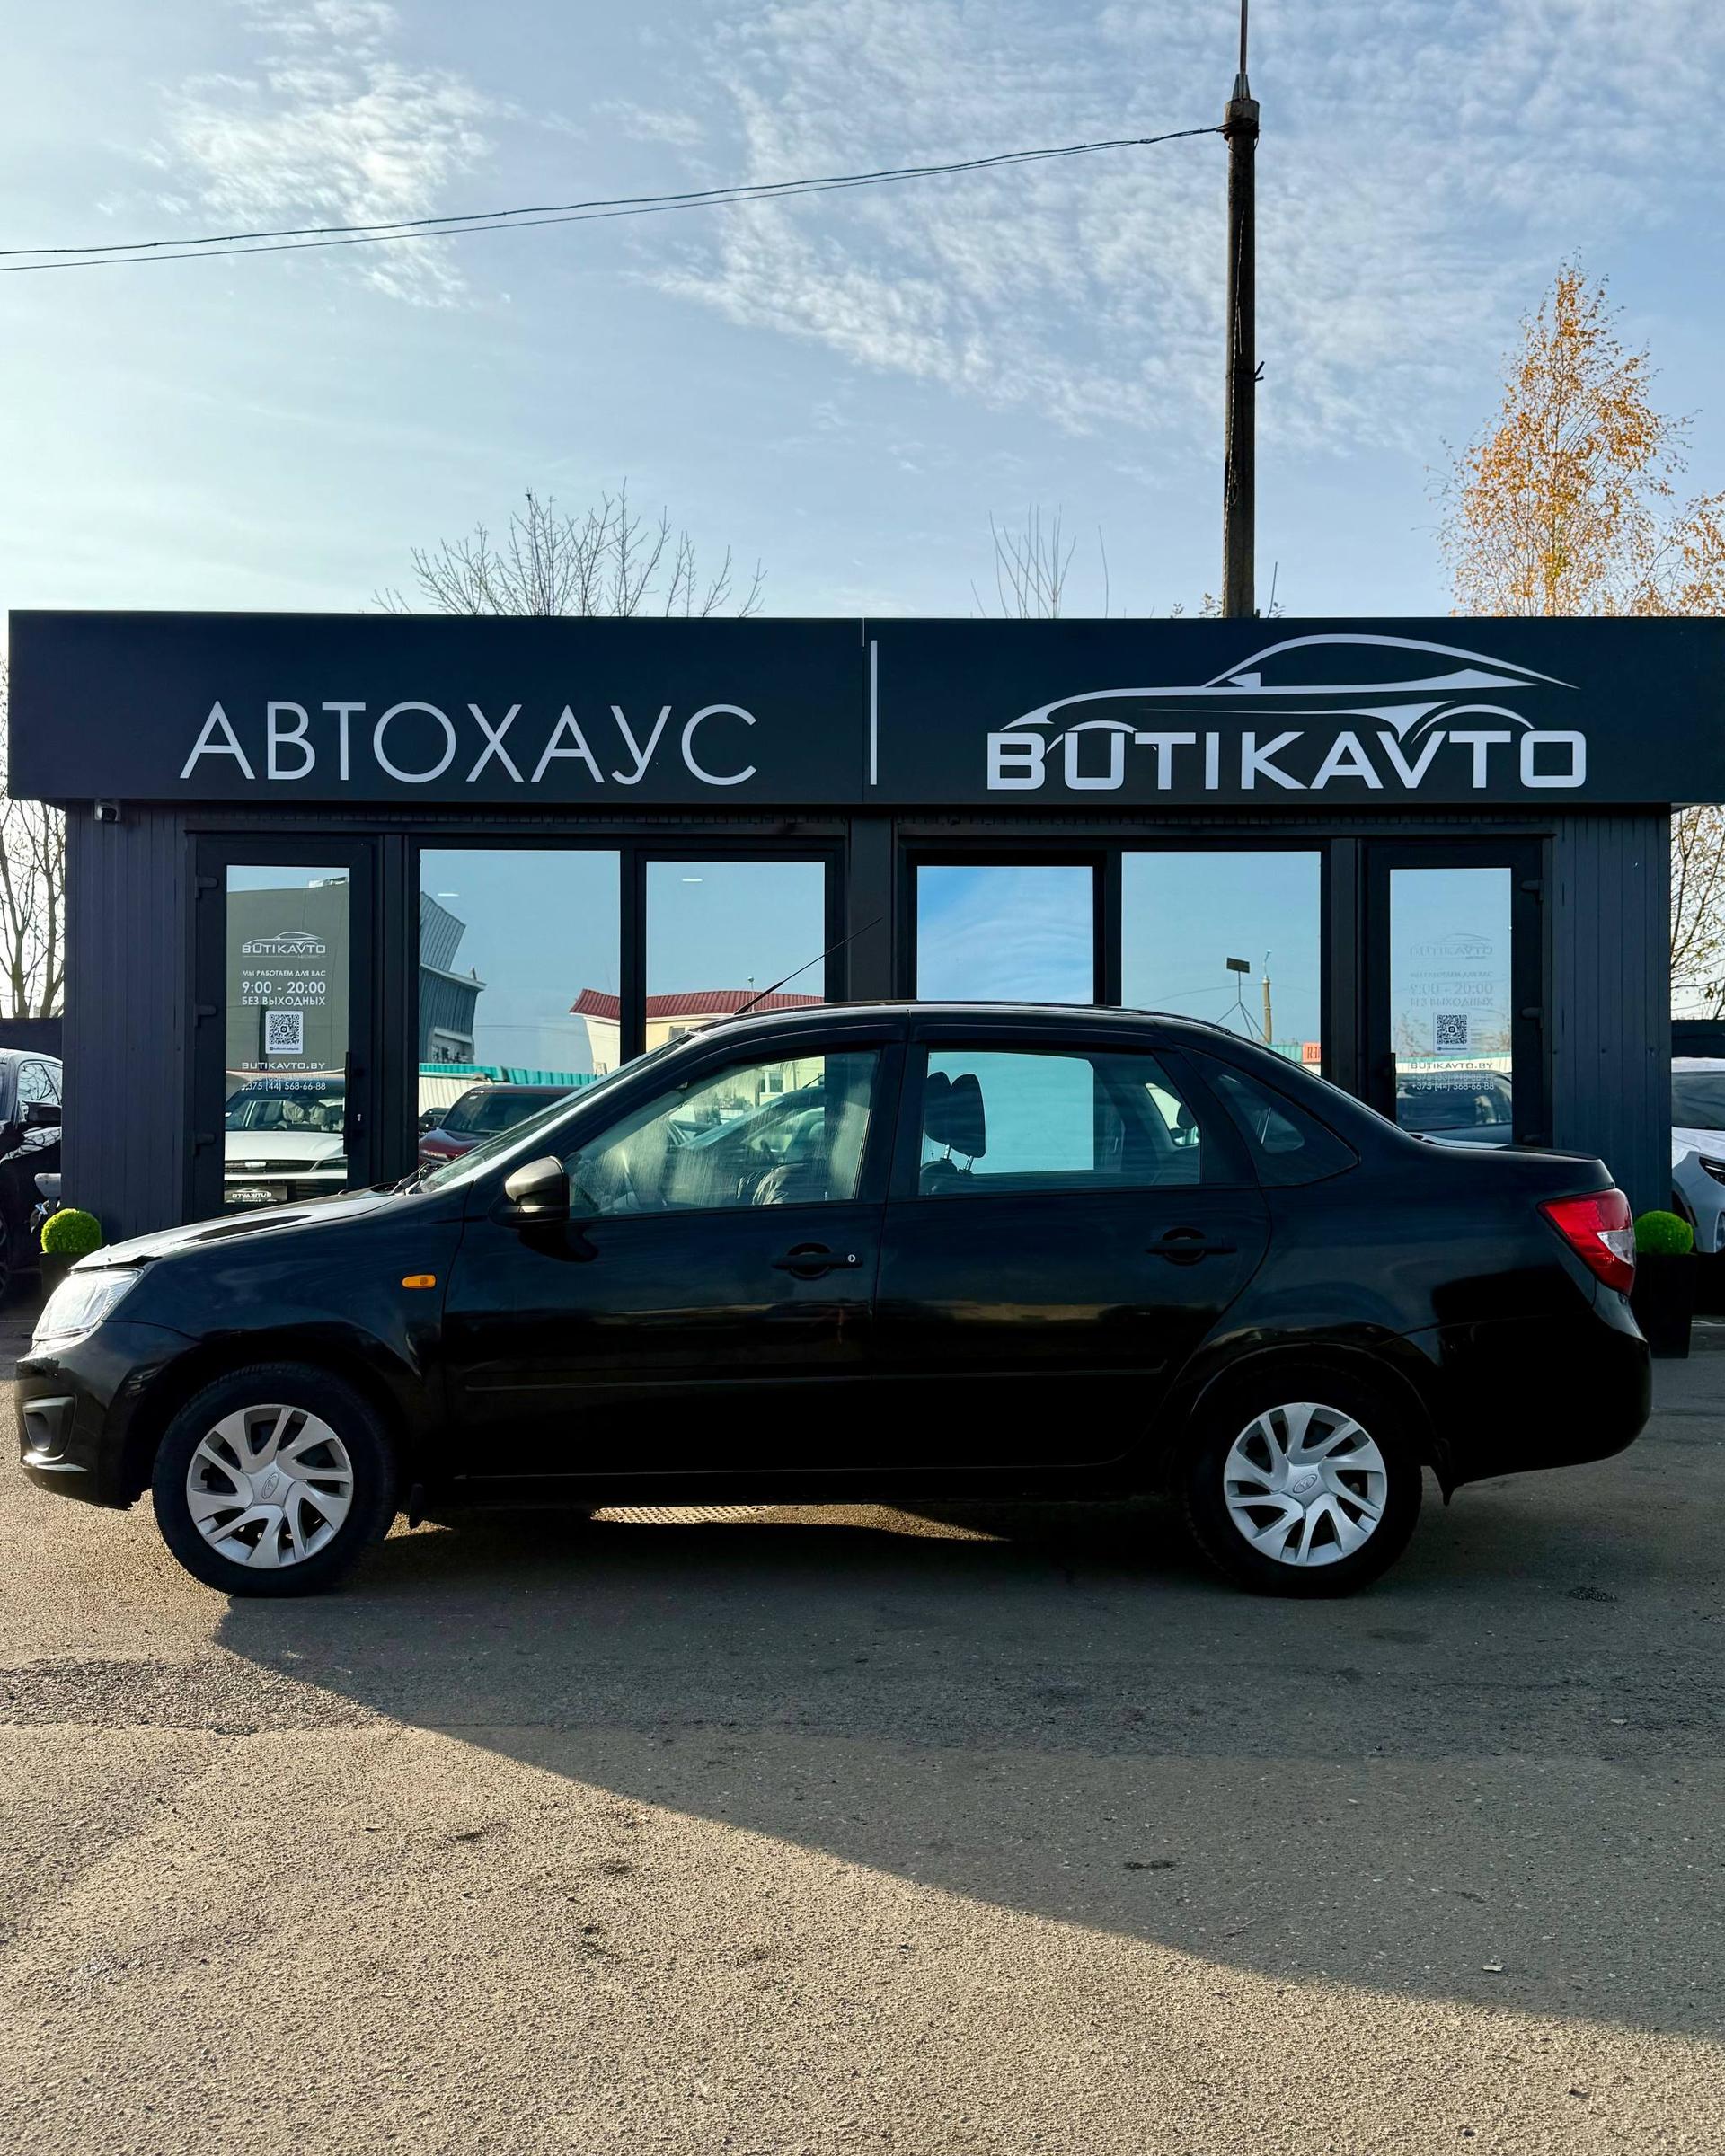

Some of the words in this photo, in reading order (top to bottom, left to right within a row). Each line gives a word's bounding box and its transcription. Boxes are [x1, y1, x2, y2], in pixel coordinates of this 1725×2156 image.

[180, 700, 756, 785] АВТОХАУС
[986, 729, 1587, 791] BUTIKAVTO
[242, 944, 326, 954] BUTIKAVTO
[242, 981, 272, 994] 9:00
[287, 981, 326, 994] 20:00
[242, 996, 259, 1005] БЕЗ
[261, 996, 325, 1006] ВЫХОДНЫХ
[242, 1062, 325, 1070] BUTIKAVTO.BY
[1411, 1062, 1493, 1070] BUTIKAVTO.BY
[265, 1081, 282, 1091] (44)
[284, 1082, 326, 1091] 568-66-88
